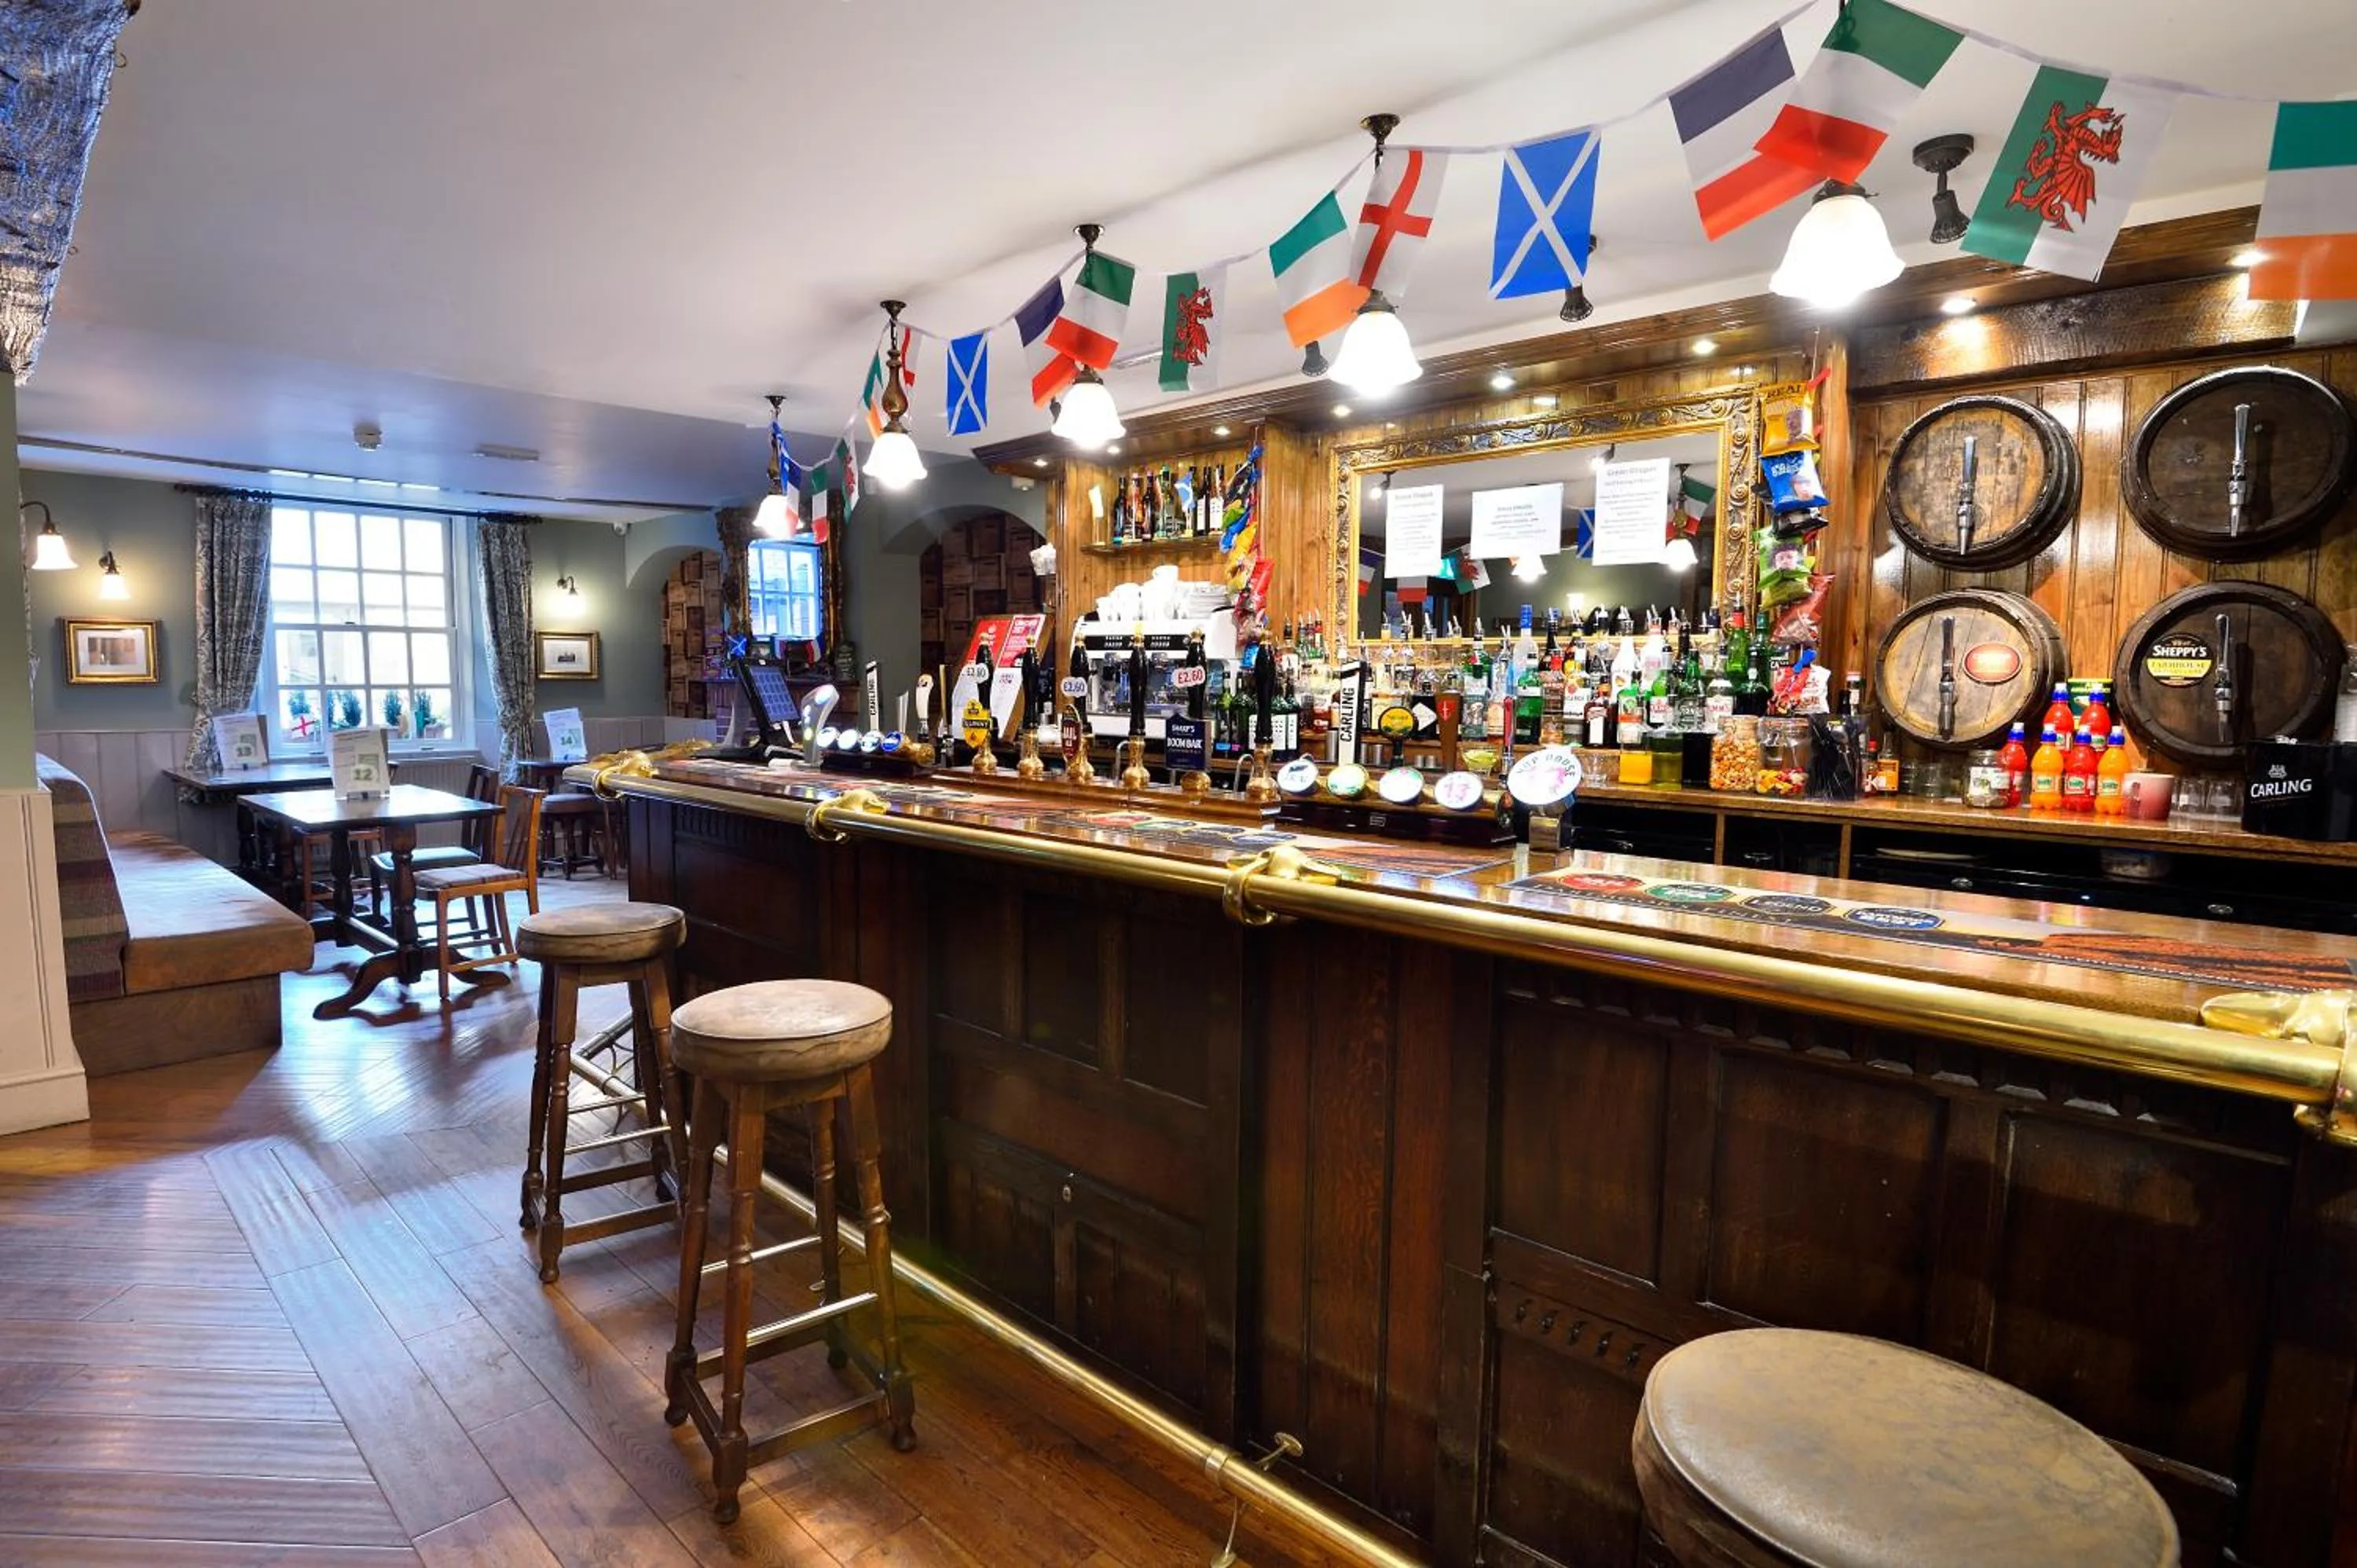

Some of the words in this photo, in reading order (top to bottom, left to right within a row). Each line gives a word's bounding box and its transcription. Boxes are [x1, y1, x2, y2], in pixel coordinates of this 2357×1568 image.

[2153, 644, 2207, 658] SHEPPY'S
[1340, 687, 1355, 742] CARLING
[354, 768, 373, 781] 12
[2250, 779, 2312, 798] CARLING
